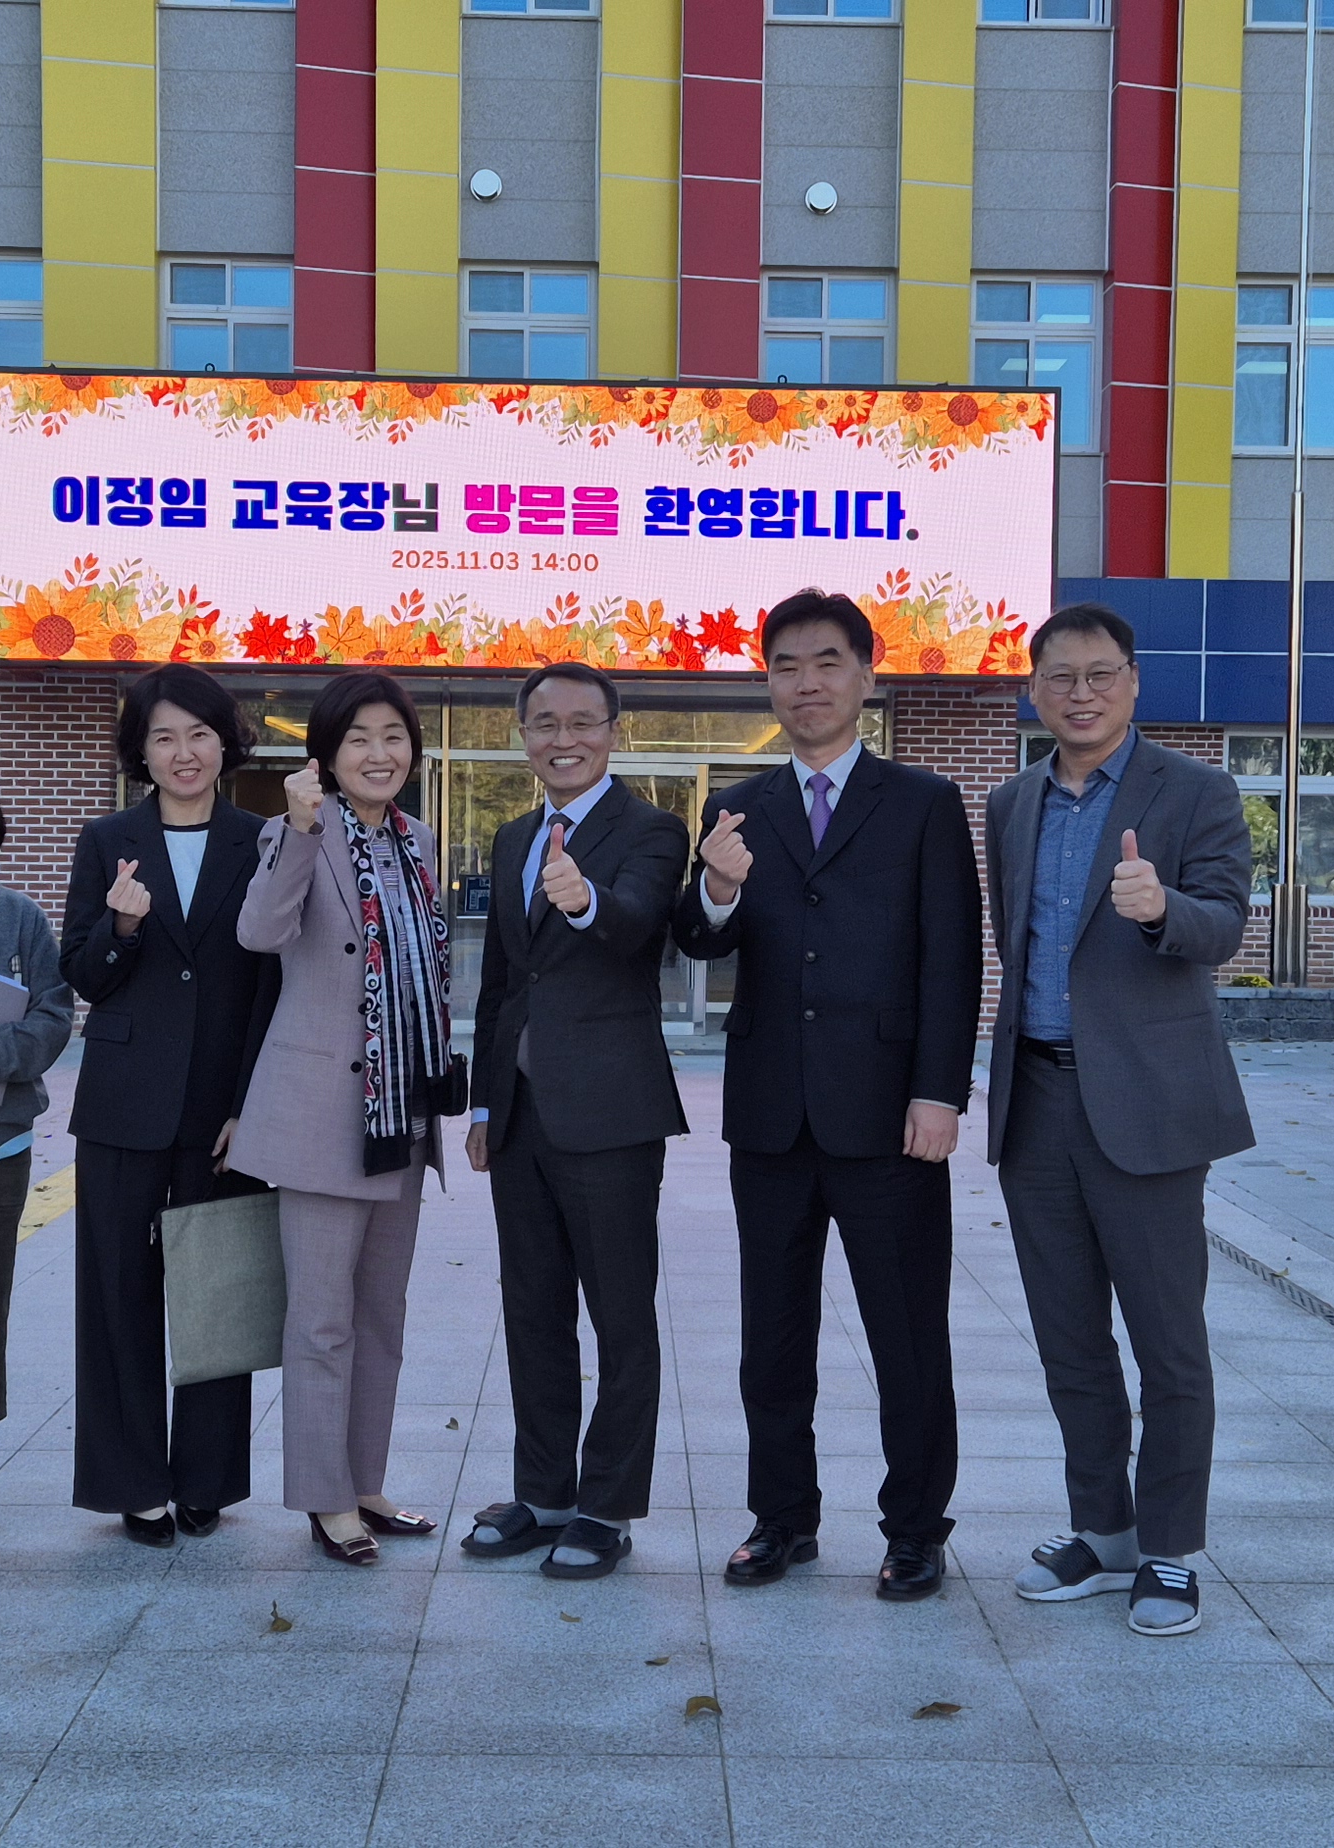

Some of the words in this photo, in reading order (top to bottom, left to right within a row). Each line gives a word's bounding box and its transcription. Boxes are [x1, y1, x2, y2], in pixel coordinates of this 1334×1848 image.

[52, 475, 207, 528] 이정임
[231, 479, 439, 532] 교육장님
[463, 483, 620, 536] 방문을
[643, 485, 919, 541] 환영합니다.
[390, 549, 520, 570] 2025.11.03
[531, 552, 599, 572] 14:00
